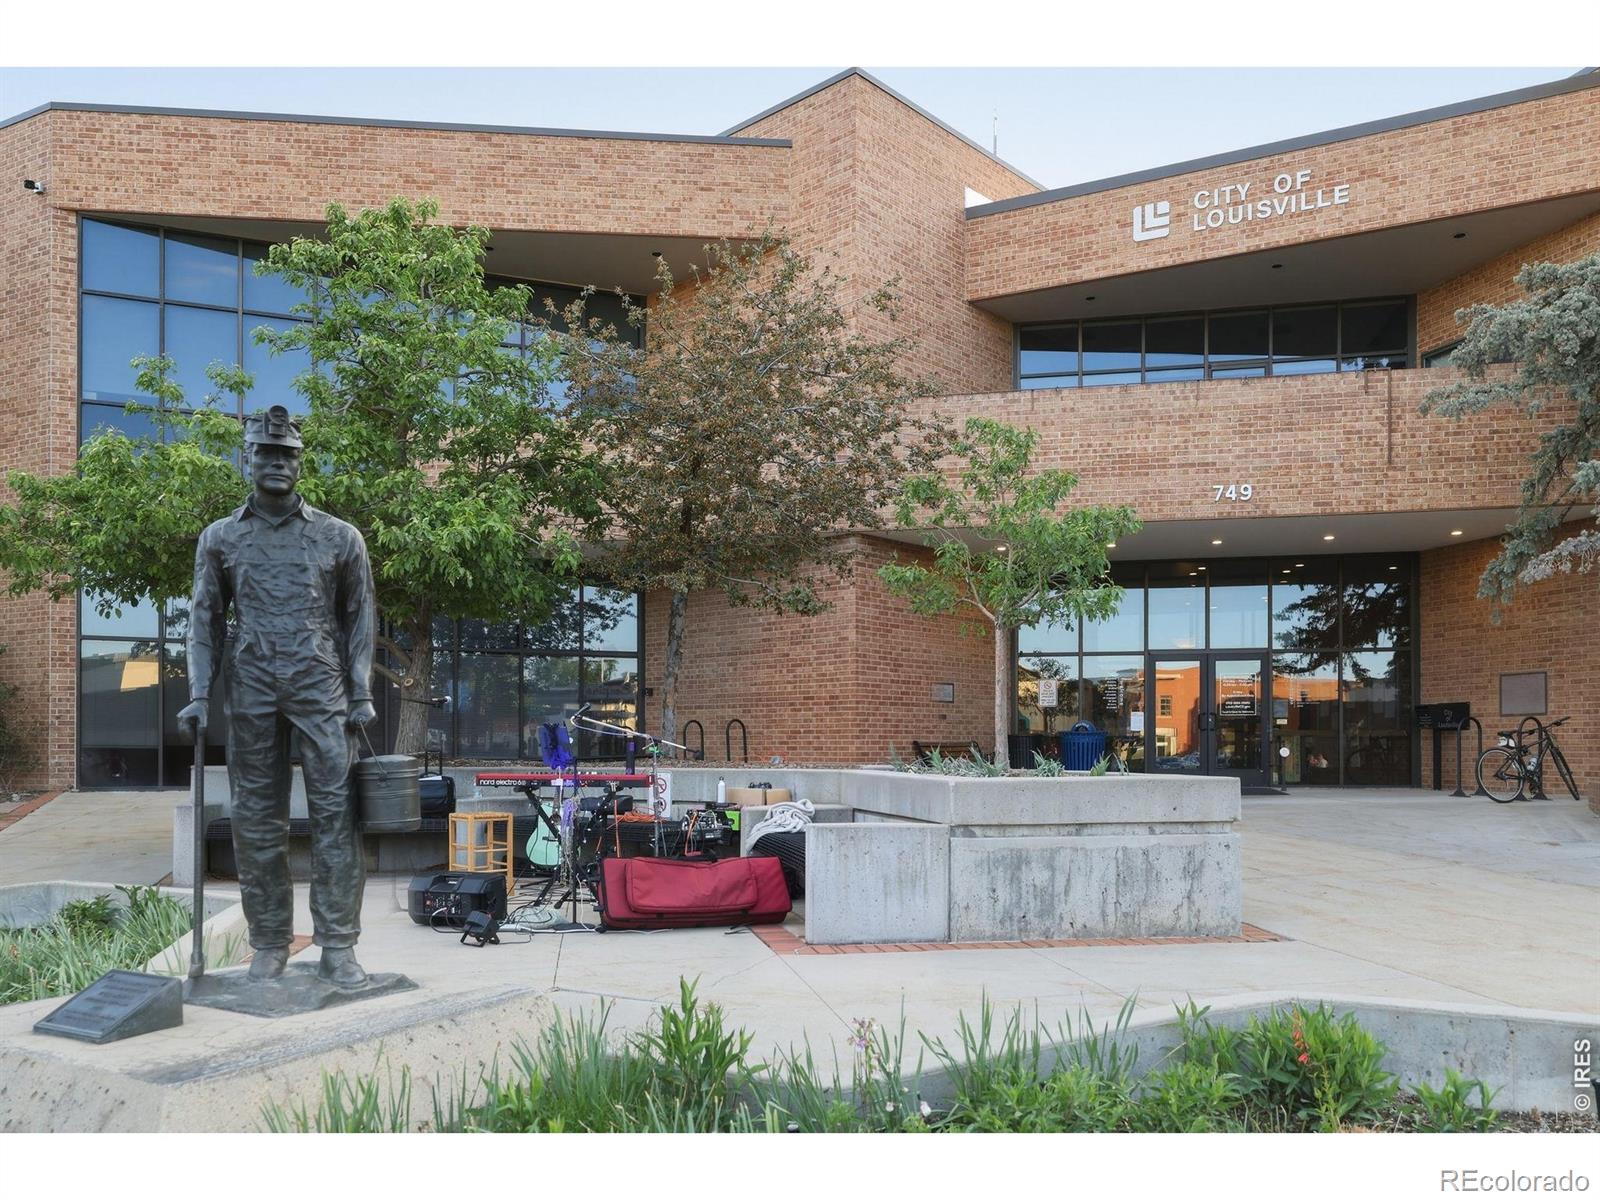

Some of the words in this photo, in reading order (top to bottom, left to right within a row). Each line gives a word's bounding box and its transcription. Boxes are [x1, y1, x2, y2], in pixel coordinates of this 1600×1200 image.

[1193, 183, 1250, 209] CITY
[1274, 170, 1312, 194] OF
[1193, 184, 1350, 231] LOUISVILLE
[1212, 484, 1253, 502] 749
